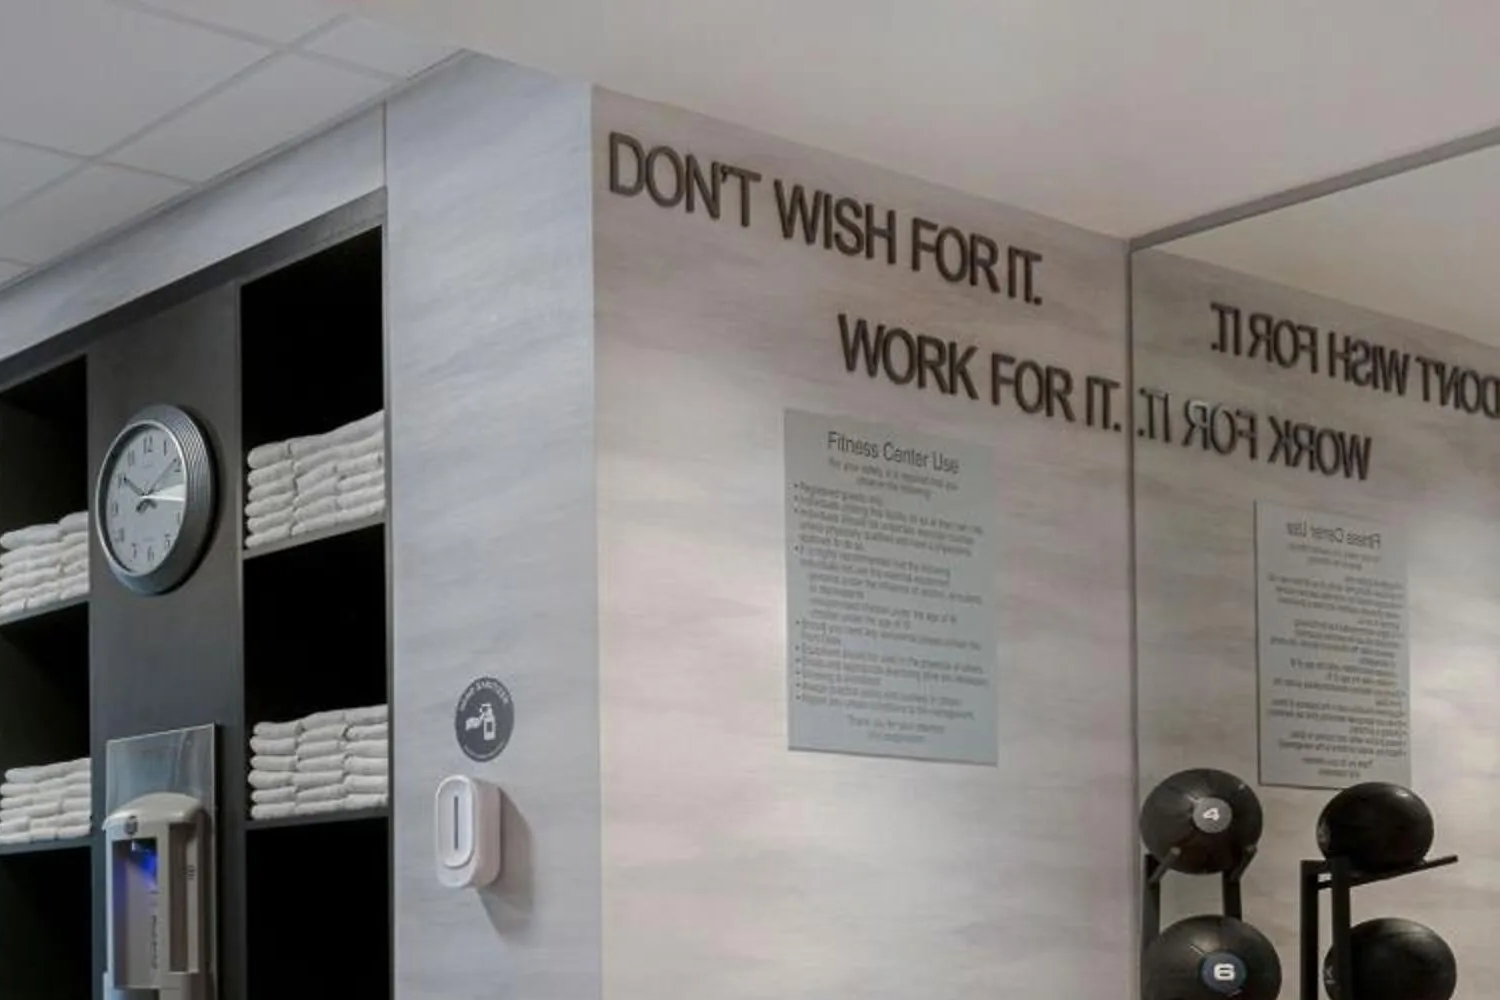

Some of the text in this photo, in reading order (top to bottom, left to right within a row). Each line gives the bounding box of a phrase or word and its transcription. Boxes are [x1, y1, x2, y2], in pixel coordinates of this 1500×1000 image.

[609, 131, 1043, 306] DON'T WISH FOR IT.
[838, 313, 1121, 432] WORK FOR IT.
[828, 431, 960, 475] Fitness Center Use
[1203, 807, 1220, 821] 4
[1213, 962, 1235, 981] 6
